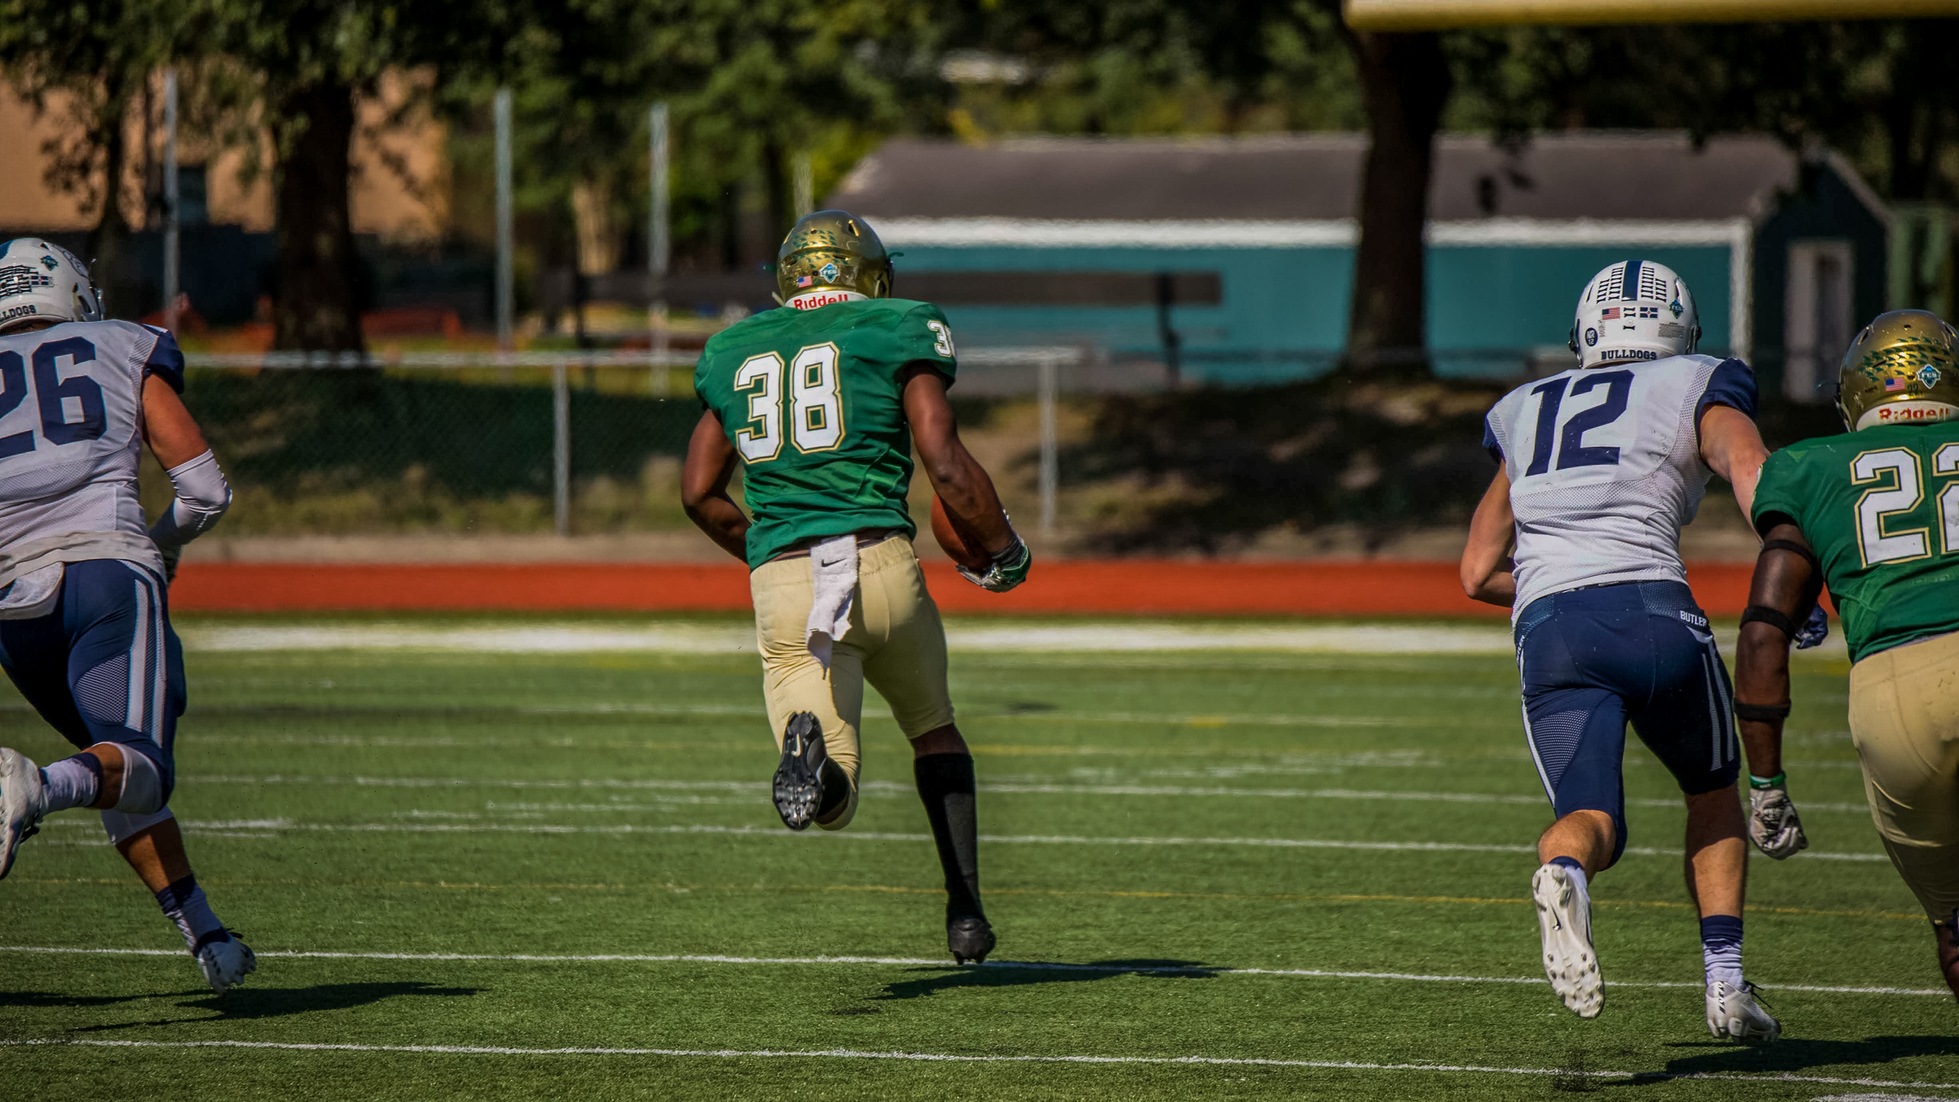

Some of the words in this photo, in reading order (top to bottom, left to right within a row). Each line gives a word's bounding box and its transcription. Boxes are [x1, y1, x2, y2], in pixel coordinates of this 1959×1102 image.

[794, 294, 848, 309] Riddell
[927, 320, 956, 357] 3
[1601, 349, 1657, 360] BULLDOGS
[734, 341, 846, 464] 38
[1525, 369, 1635, 477] 12
[1680, 610, 1707, 626] BUTLER
